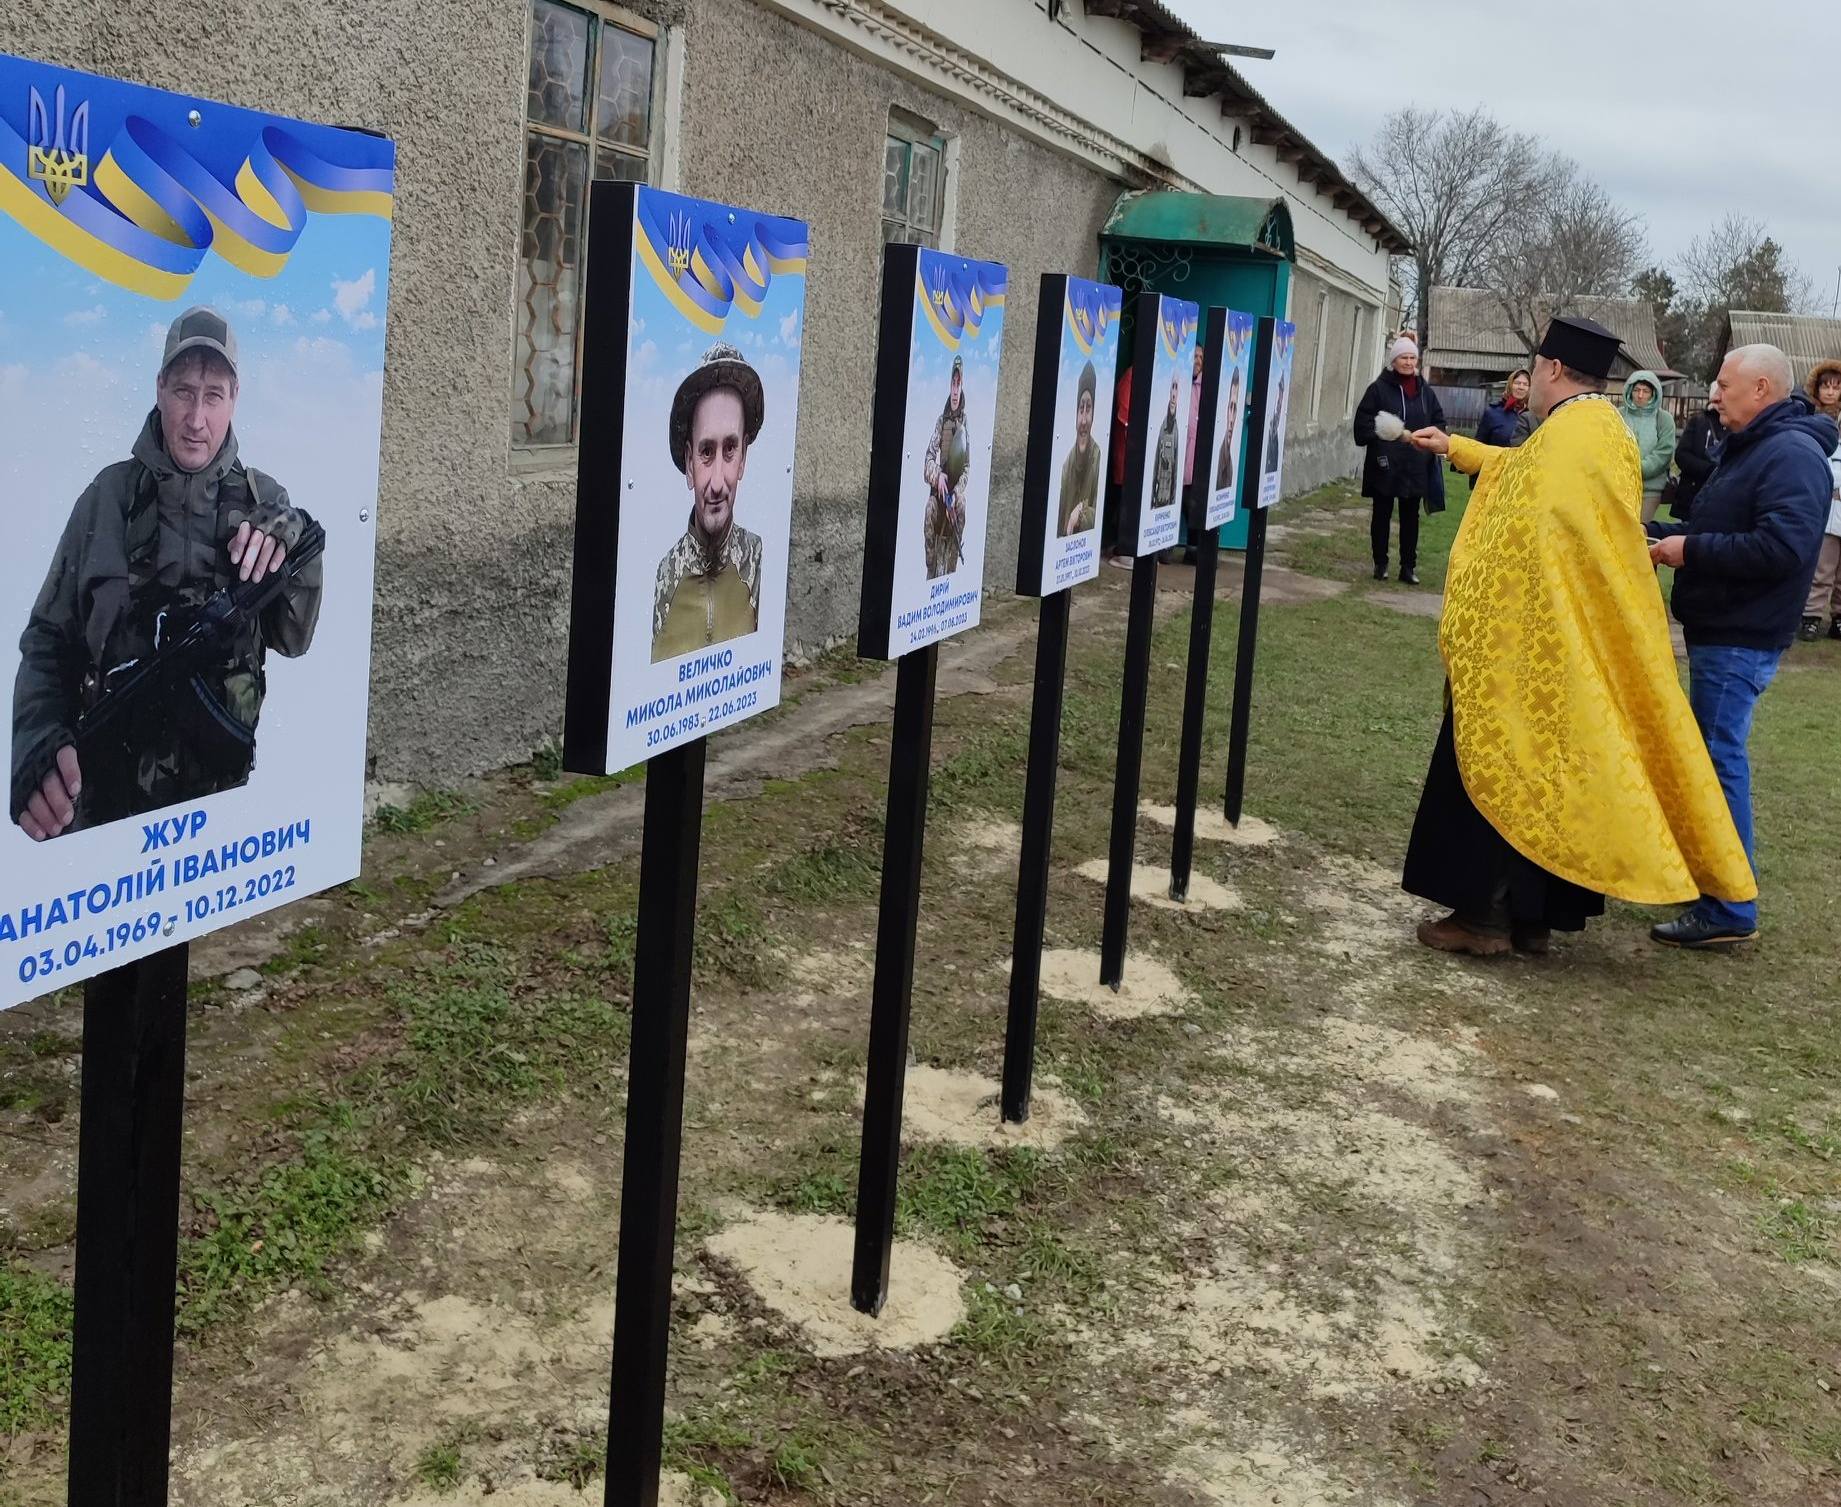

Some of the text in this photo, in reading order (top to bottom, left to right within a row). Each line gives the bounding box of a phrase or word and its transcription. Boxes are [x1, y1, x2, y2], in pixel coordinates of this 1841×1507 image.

[897, 590, 978, 629] ВАДИМ ВОЛОДИМИРОВИЧ
[930, 578, 950, 600] ДИРІЙ
[679, 649, 733, 682] ВЕЛИЧКО
[626, 660, 772, 729] МИКОЛА МИКОЛАЙОВИЧ
[647, 691, 757, 747] 30.06.1983 22.06.2023
[141, 810, 207, 854] ЖУР
[0, 818, 311, 943] АНАТОЛІЙ ІВАНОВИЧ
[19, 911, 161, 983] 03.04.1969
[185, 865, 296, 923] 10.12.2022
